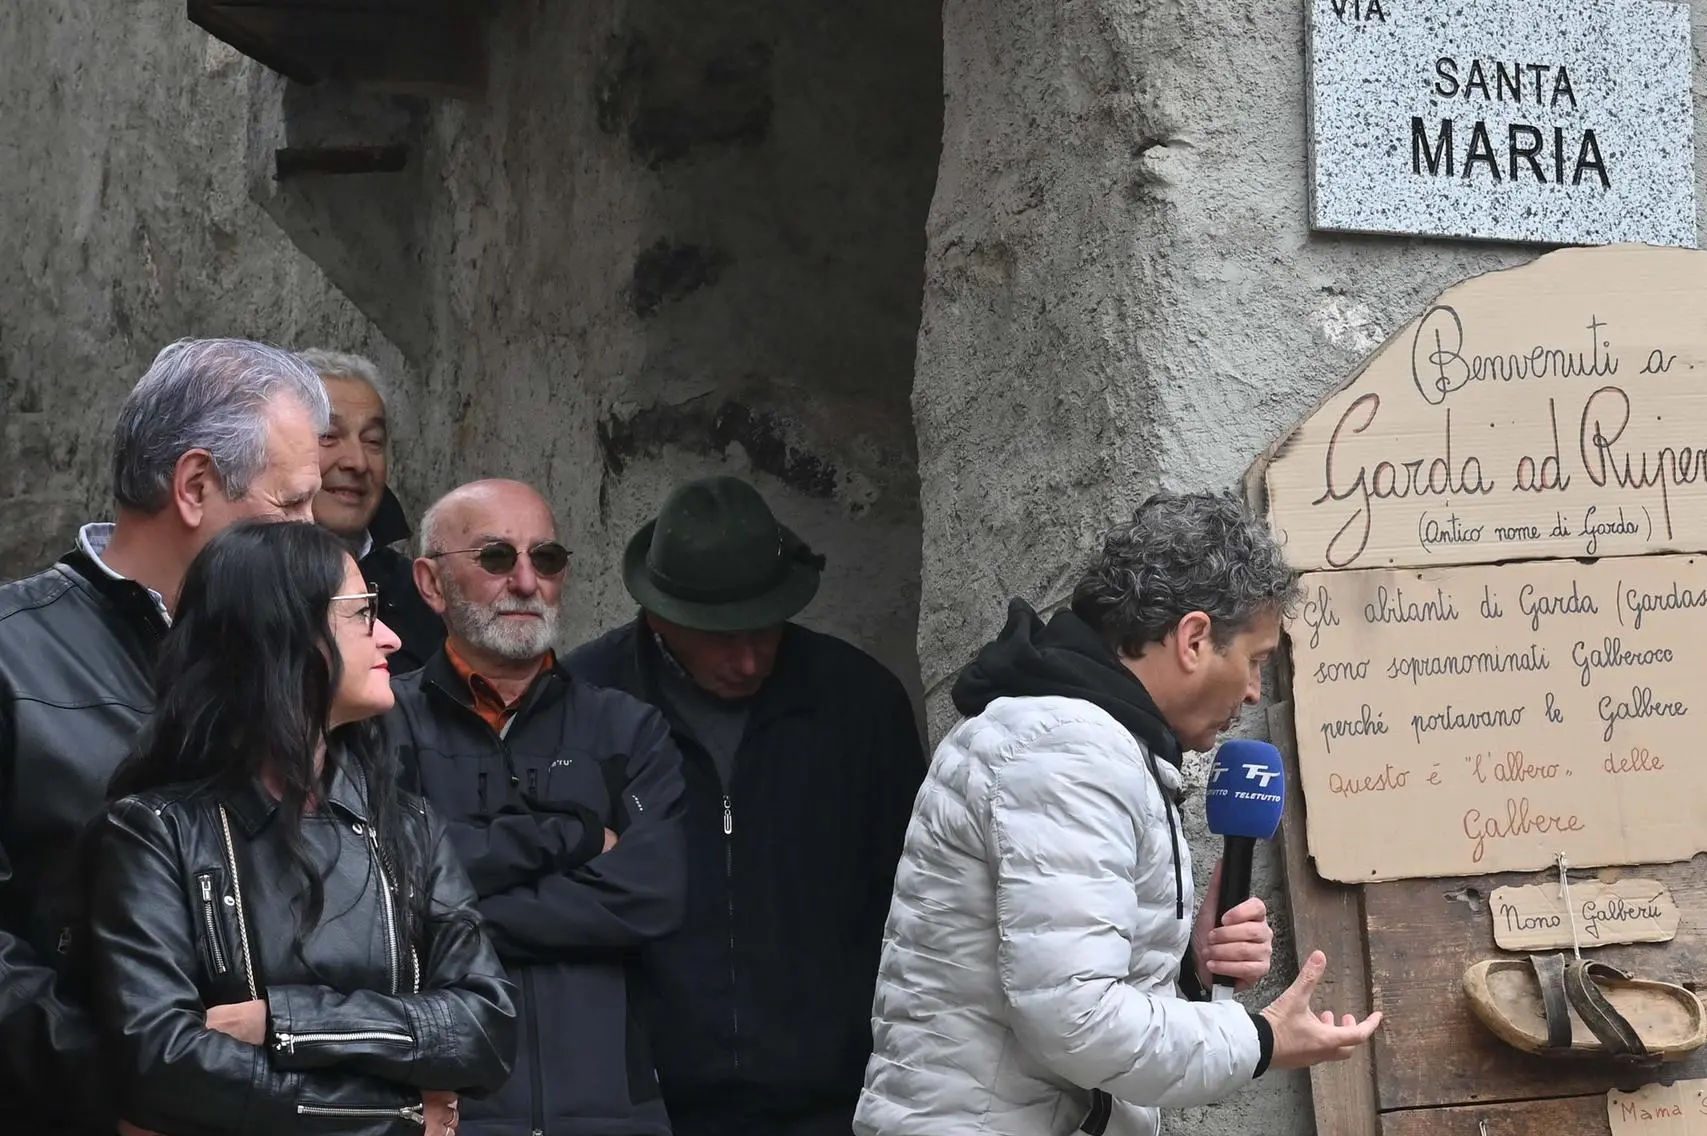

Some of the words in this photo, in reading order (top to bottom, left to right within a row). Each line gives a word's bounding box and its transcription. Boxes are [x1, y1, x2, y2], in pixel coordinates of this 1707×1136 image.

[1331, 0, 1386, 22] VIA
[1435, 57, 1577, 107] SANTA
[1411, 116, 1610, 189] MARIA
[1412, 305, 1619, 405] Benvenuti
[1640, 348, 1677, 375] a
[1312, 393, 1495, 567] Garda
[1512, 398, 1571, 493] ad
[1495, 525, 1541, 541] nome
[1549, 511, 1571, 537] di
[1303, 585, 1340, 649] Gli
[1364, 585, 1459, 623] abitanti
[1480, 585, 1503, 618] di
[1518, 580, 1598, 631] Garda
[1313, 659, 1370, 683] sono
[1387, 643, 1550, 685] sopranominati
[1320, 703, 1389, 754] perché
[1411, 705, 1525, 744] portavano
[1546, 692, 1564, 724] le
[1598, 686, 1688, 742] Galbere
[1235, 791, 1280, 802] TELETUTTO
[1329, 764, 1410, 798] Questo
[1604, 747, 1664, 774] delle
[1463, 797, 1585, 863] Galbere
[1500, 904, 1561, 932] Nono
[1621, 1102, 1683, 1122] Mama
